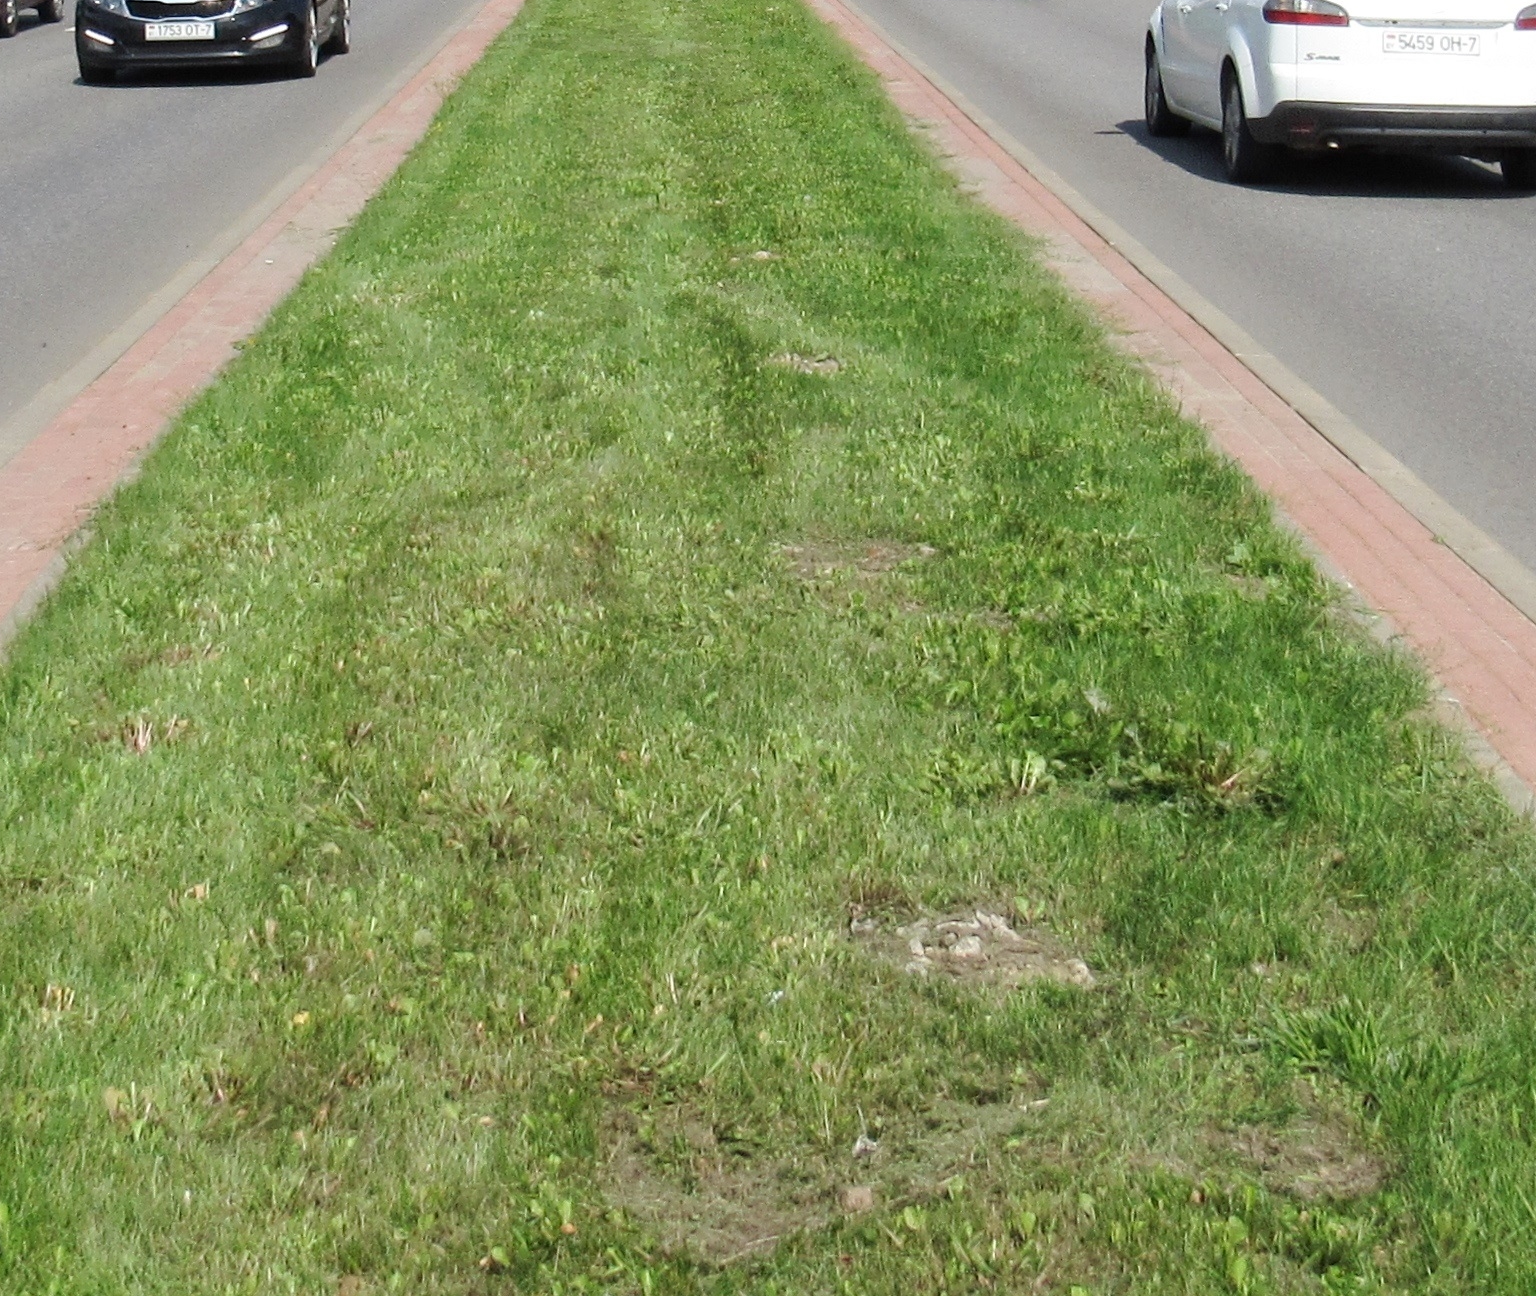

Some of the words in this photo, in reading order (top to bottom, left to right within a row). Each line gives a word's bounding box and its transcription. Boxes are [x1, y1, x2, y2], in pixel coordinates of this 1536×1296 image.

[157, 24, 182, 36] 1753
[185, 24, 212, 36] OT-7
[1398, 34, 1434, 50] 5459
[1440, 36, 1477, 52] OH-7
